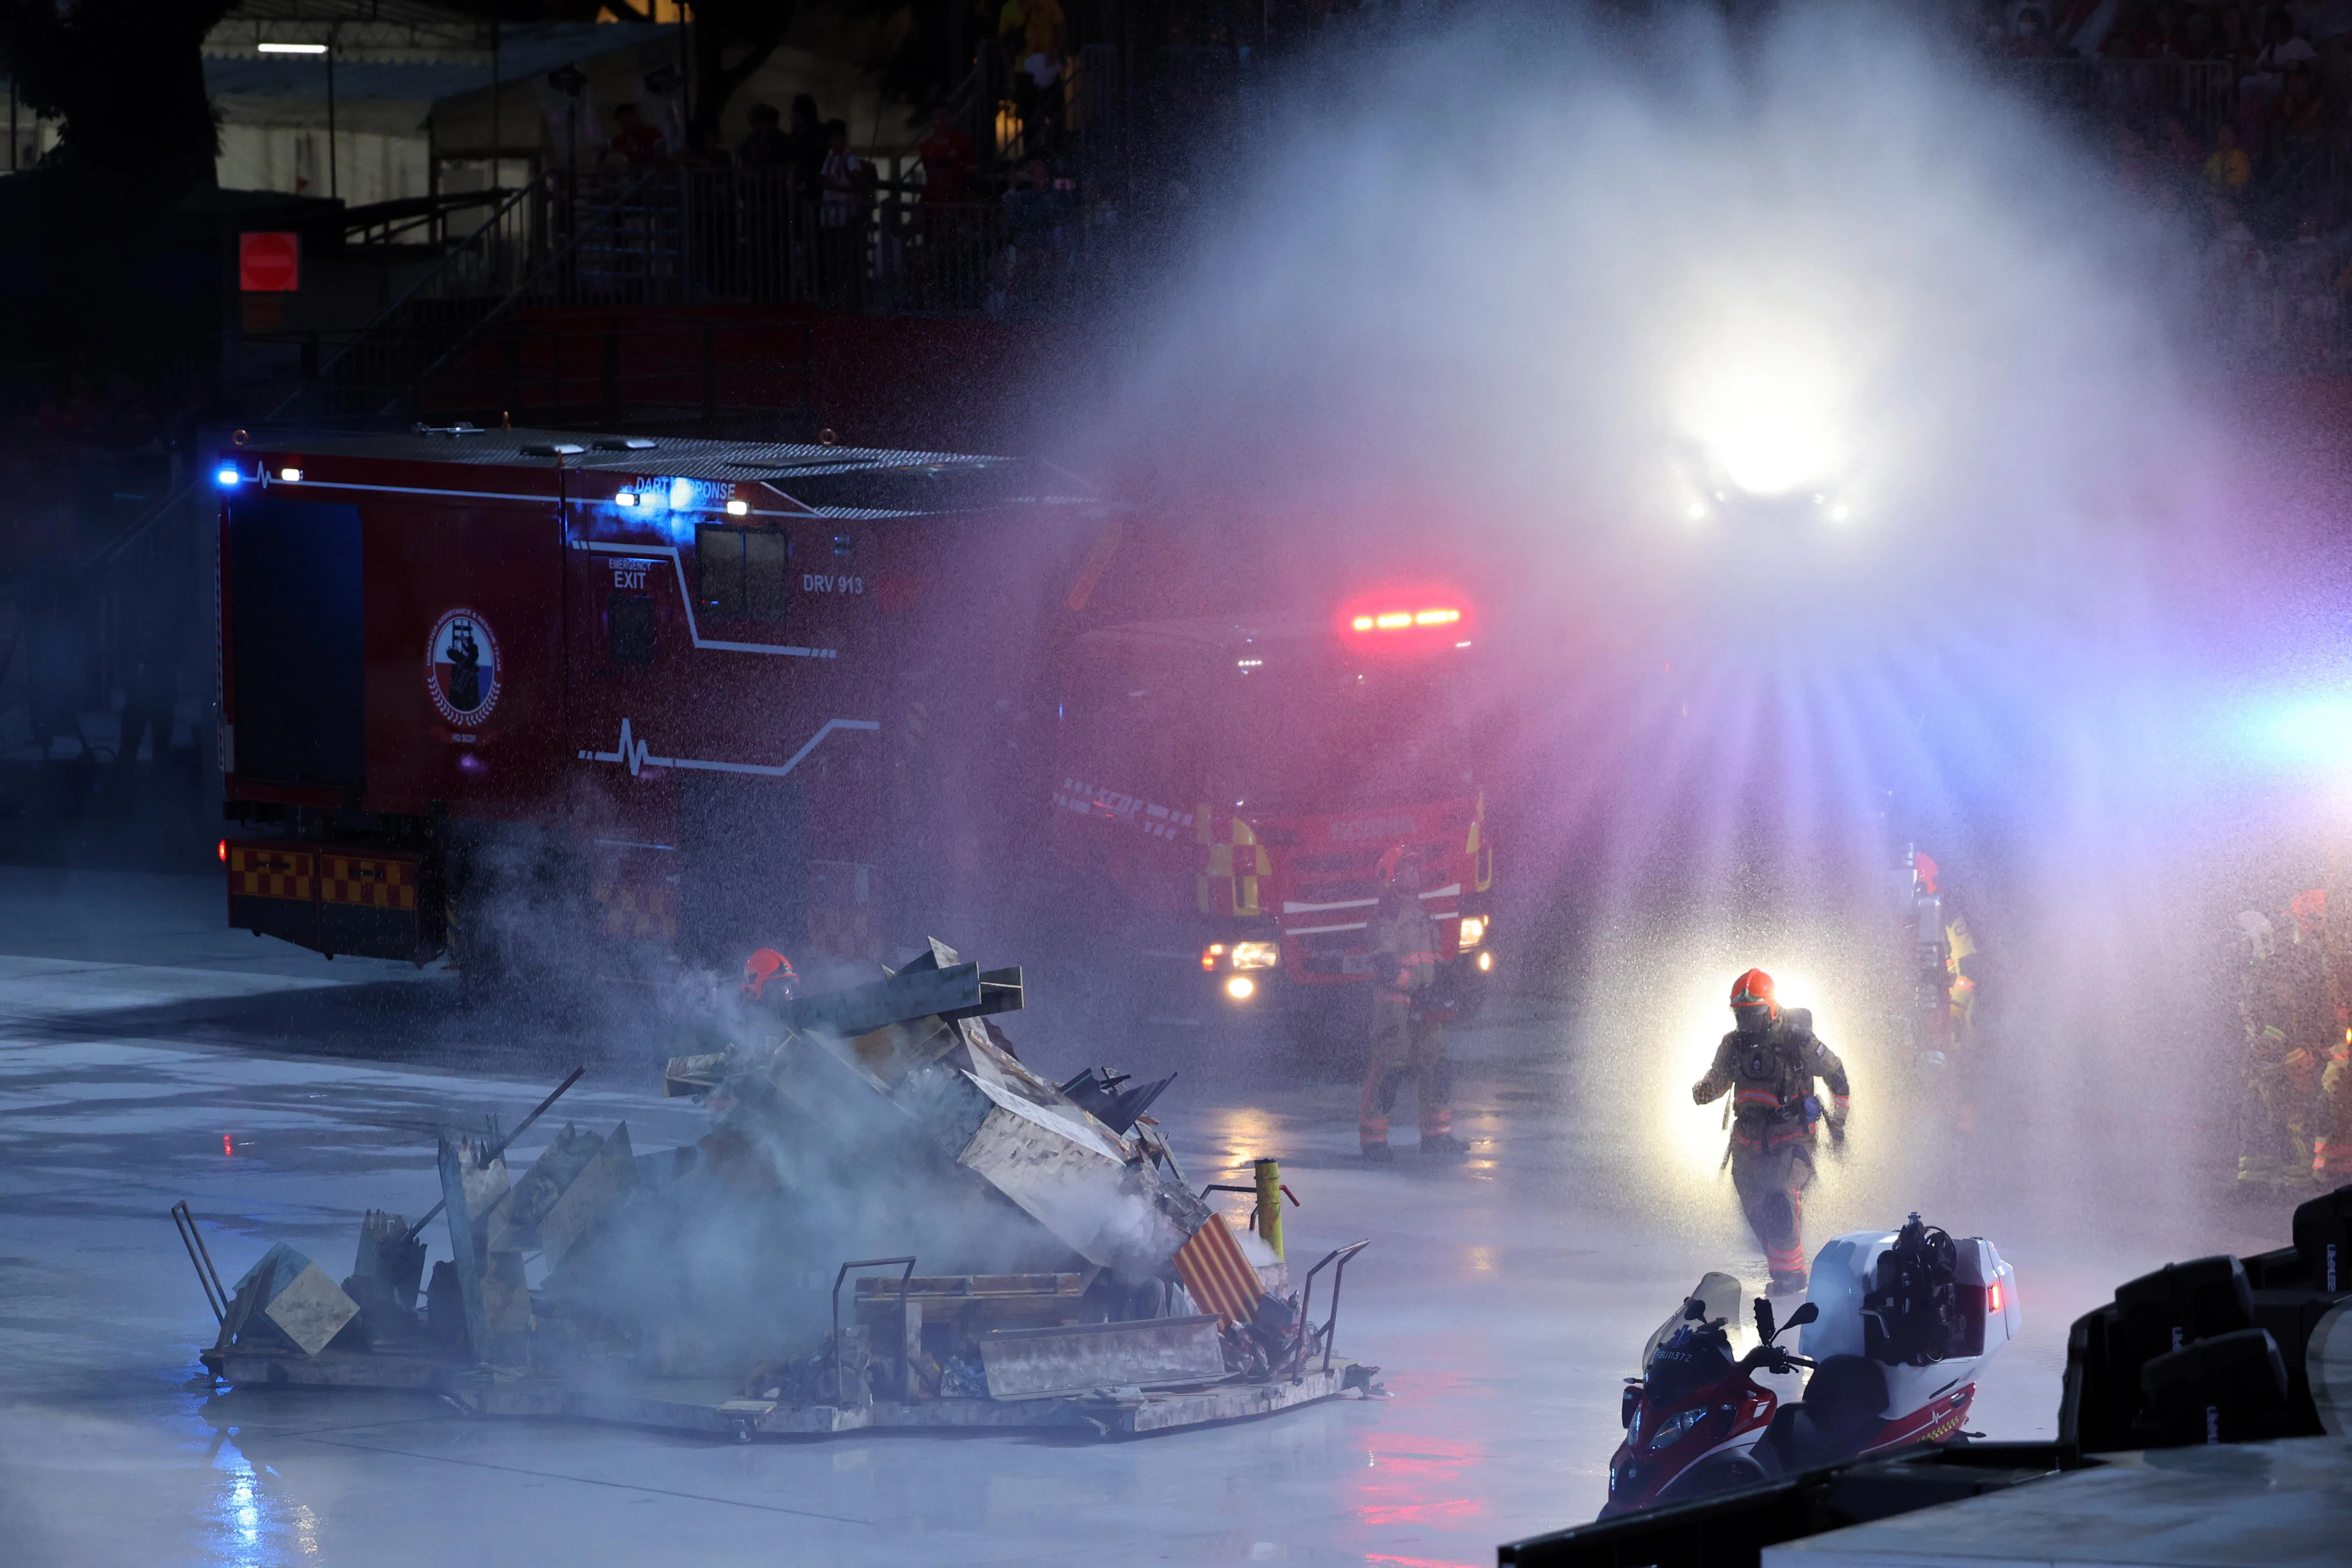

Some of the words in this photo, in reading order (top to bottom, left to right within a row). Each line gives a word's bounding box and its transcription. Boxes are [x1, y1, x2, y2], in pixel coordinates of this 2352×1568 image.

[636, 476, 670, 494] DART
[670, 477, 736, 501] SPONSE
[609, 557, 651, 571] EMERGENCY
[614, 570, 646, 588] EXIT
[803, 574, 834, 592] DRV
[838, 576, 863, 594] 913
[1655, 1351, 1693, 1362] FBU1137Z
